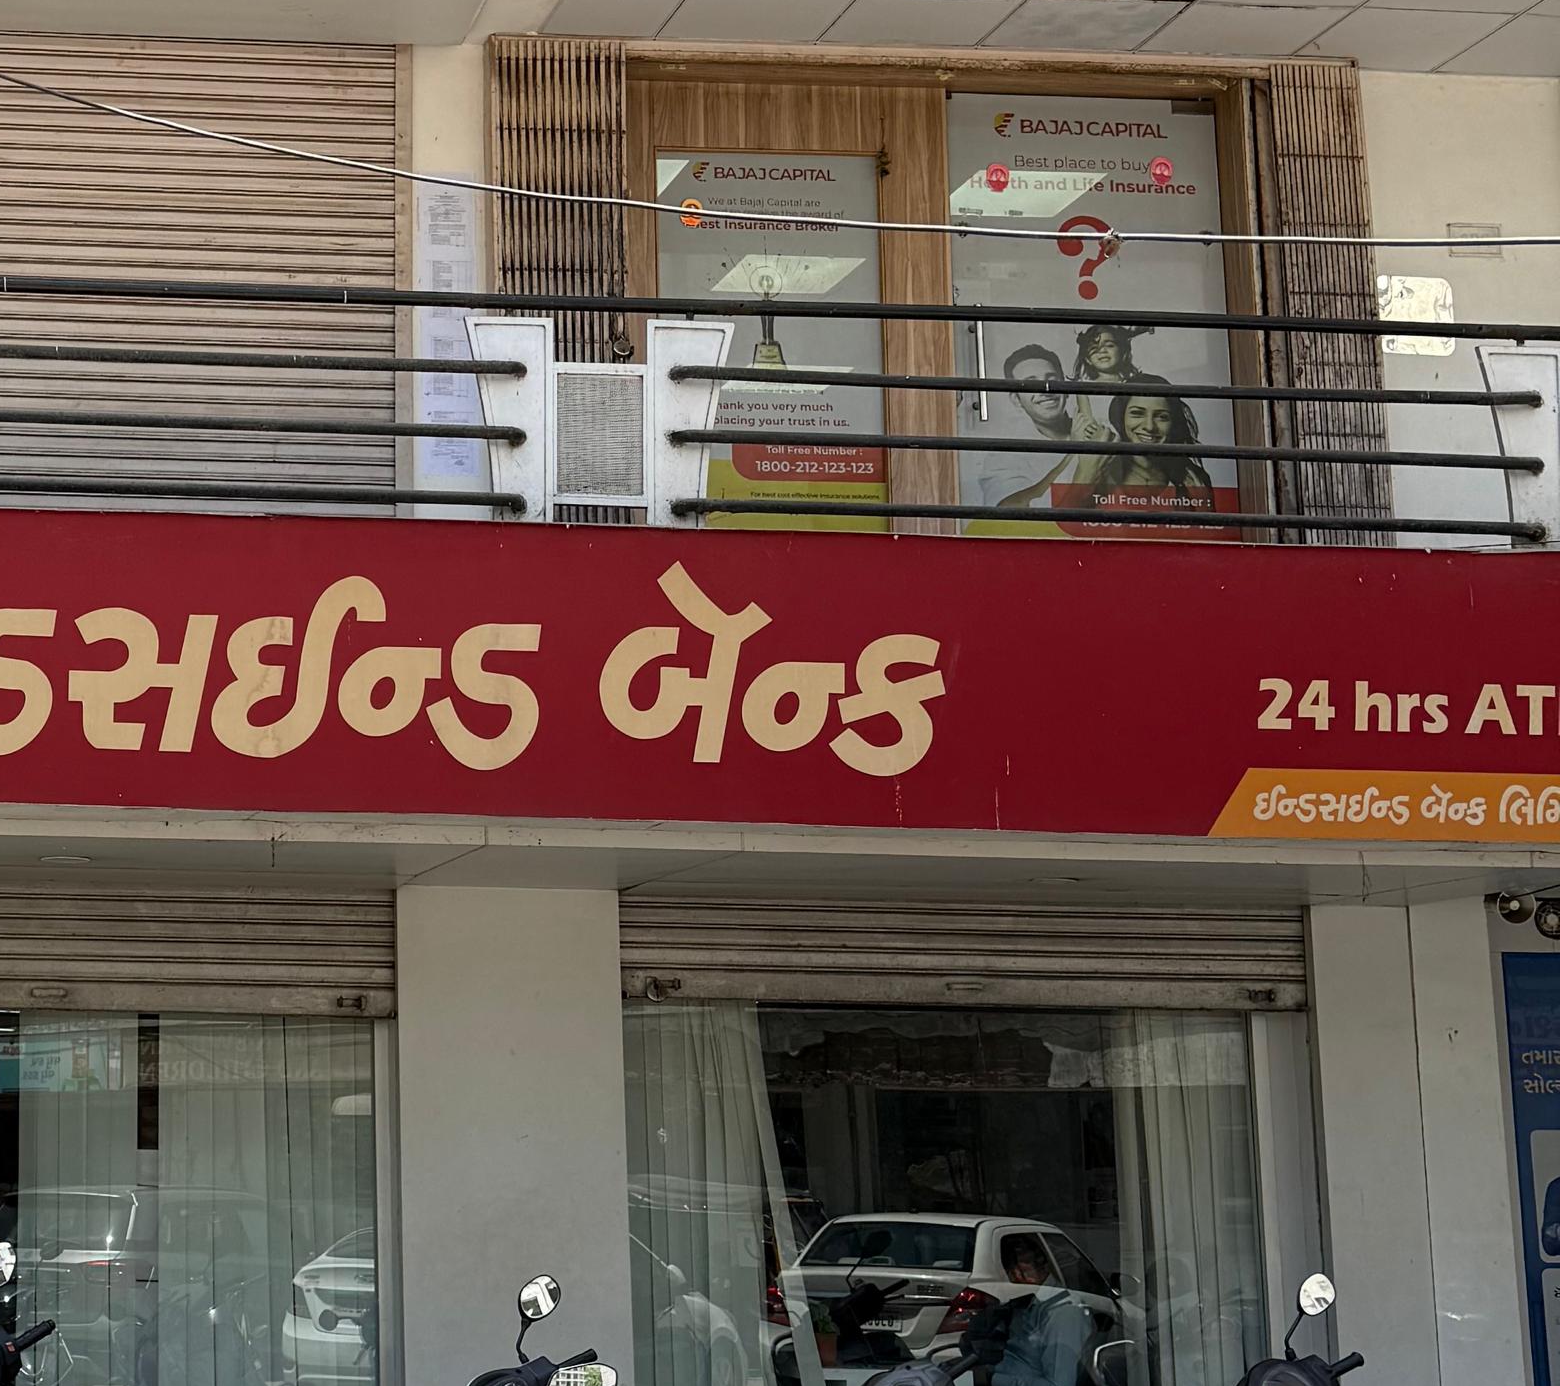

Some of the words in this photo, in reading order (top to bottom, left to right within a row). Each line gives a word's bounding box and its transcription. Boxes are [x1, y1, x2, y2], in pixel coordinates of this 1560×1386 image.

[1020, 119, 1083, 135] BAJAJ
[1087, 121, 1168, 138] CAPITAL
[1014, 154, 1049, 168] Best
[1054, 156, 1096, 172] place
[1100, 158, 1116, 170] to
[1121, 158, 1150, 173] buy
[713, 166, 766, 180] BAJAJ
[769, 168, 836, 182] CAPITAL
[1034, 177, 1067, 191] and
[1073, 178, 1104, 192] Life
[1110, 179, 1196, 195] Insurance
[708, 197, 725, 206] We
[727, 198, 737, 206] at
[740, 197, 764, 208] Bajaj
[767, 198, 802, 208] Capital
[725, 219, 790, 231] Insurance
[747, 403, 768, 412] you
[771, 403, 797, 413] very
[801, 403, 833, 412] much
[758, 417, 785, 427] your
[788, 417, 816, 427] trust
[819, 417, 830, 427] in
[833, 418, 850, 427] us.
[766, 445, 785, 454] Toll
[788, 446, 810, 455] Free
[814, 446, 857, 456] Number
[755, 460, 874, 474] 1800-212-123-123
[1093, 494, 1115, 505] Toll
[1119, 494, 1148, 506] Free
[1151, 495, 1203, 507] Number
[1257, 678, 1335, 730] 24
[1354, 681, 1449, 734] hrs
[1464, 683, 1560, 735] AT
